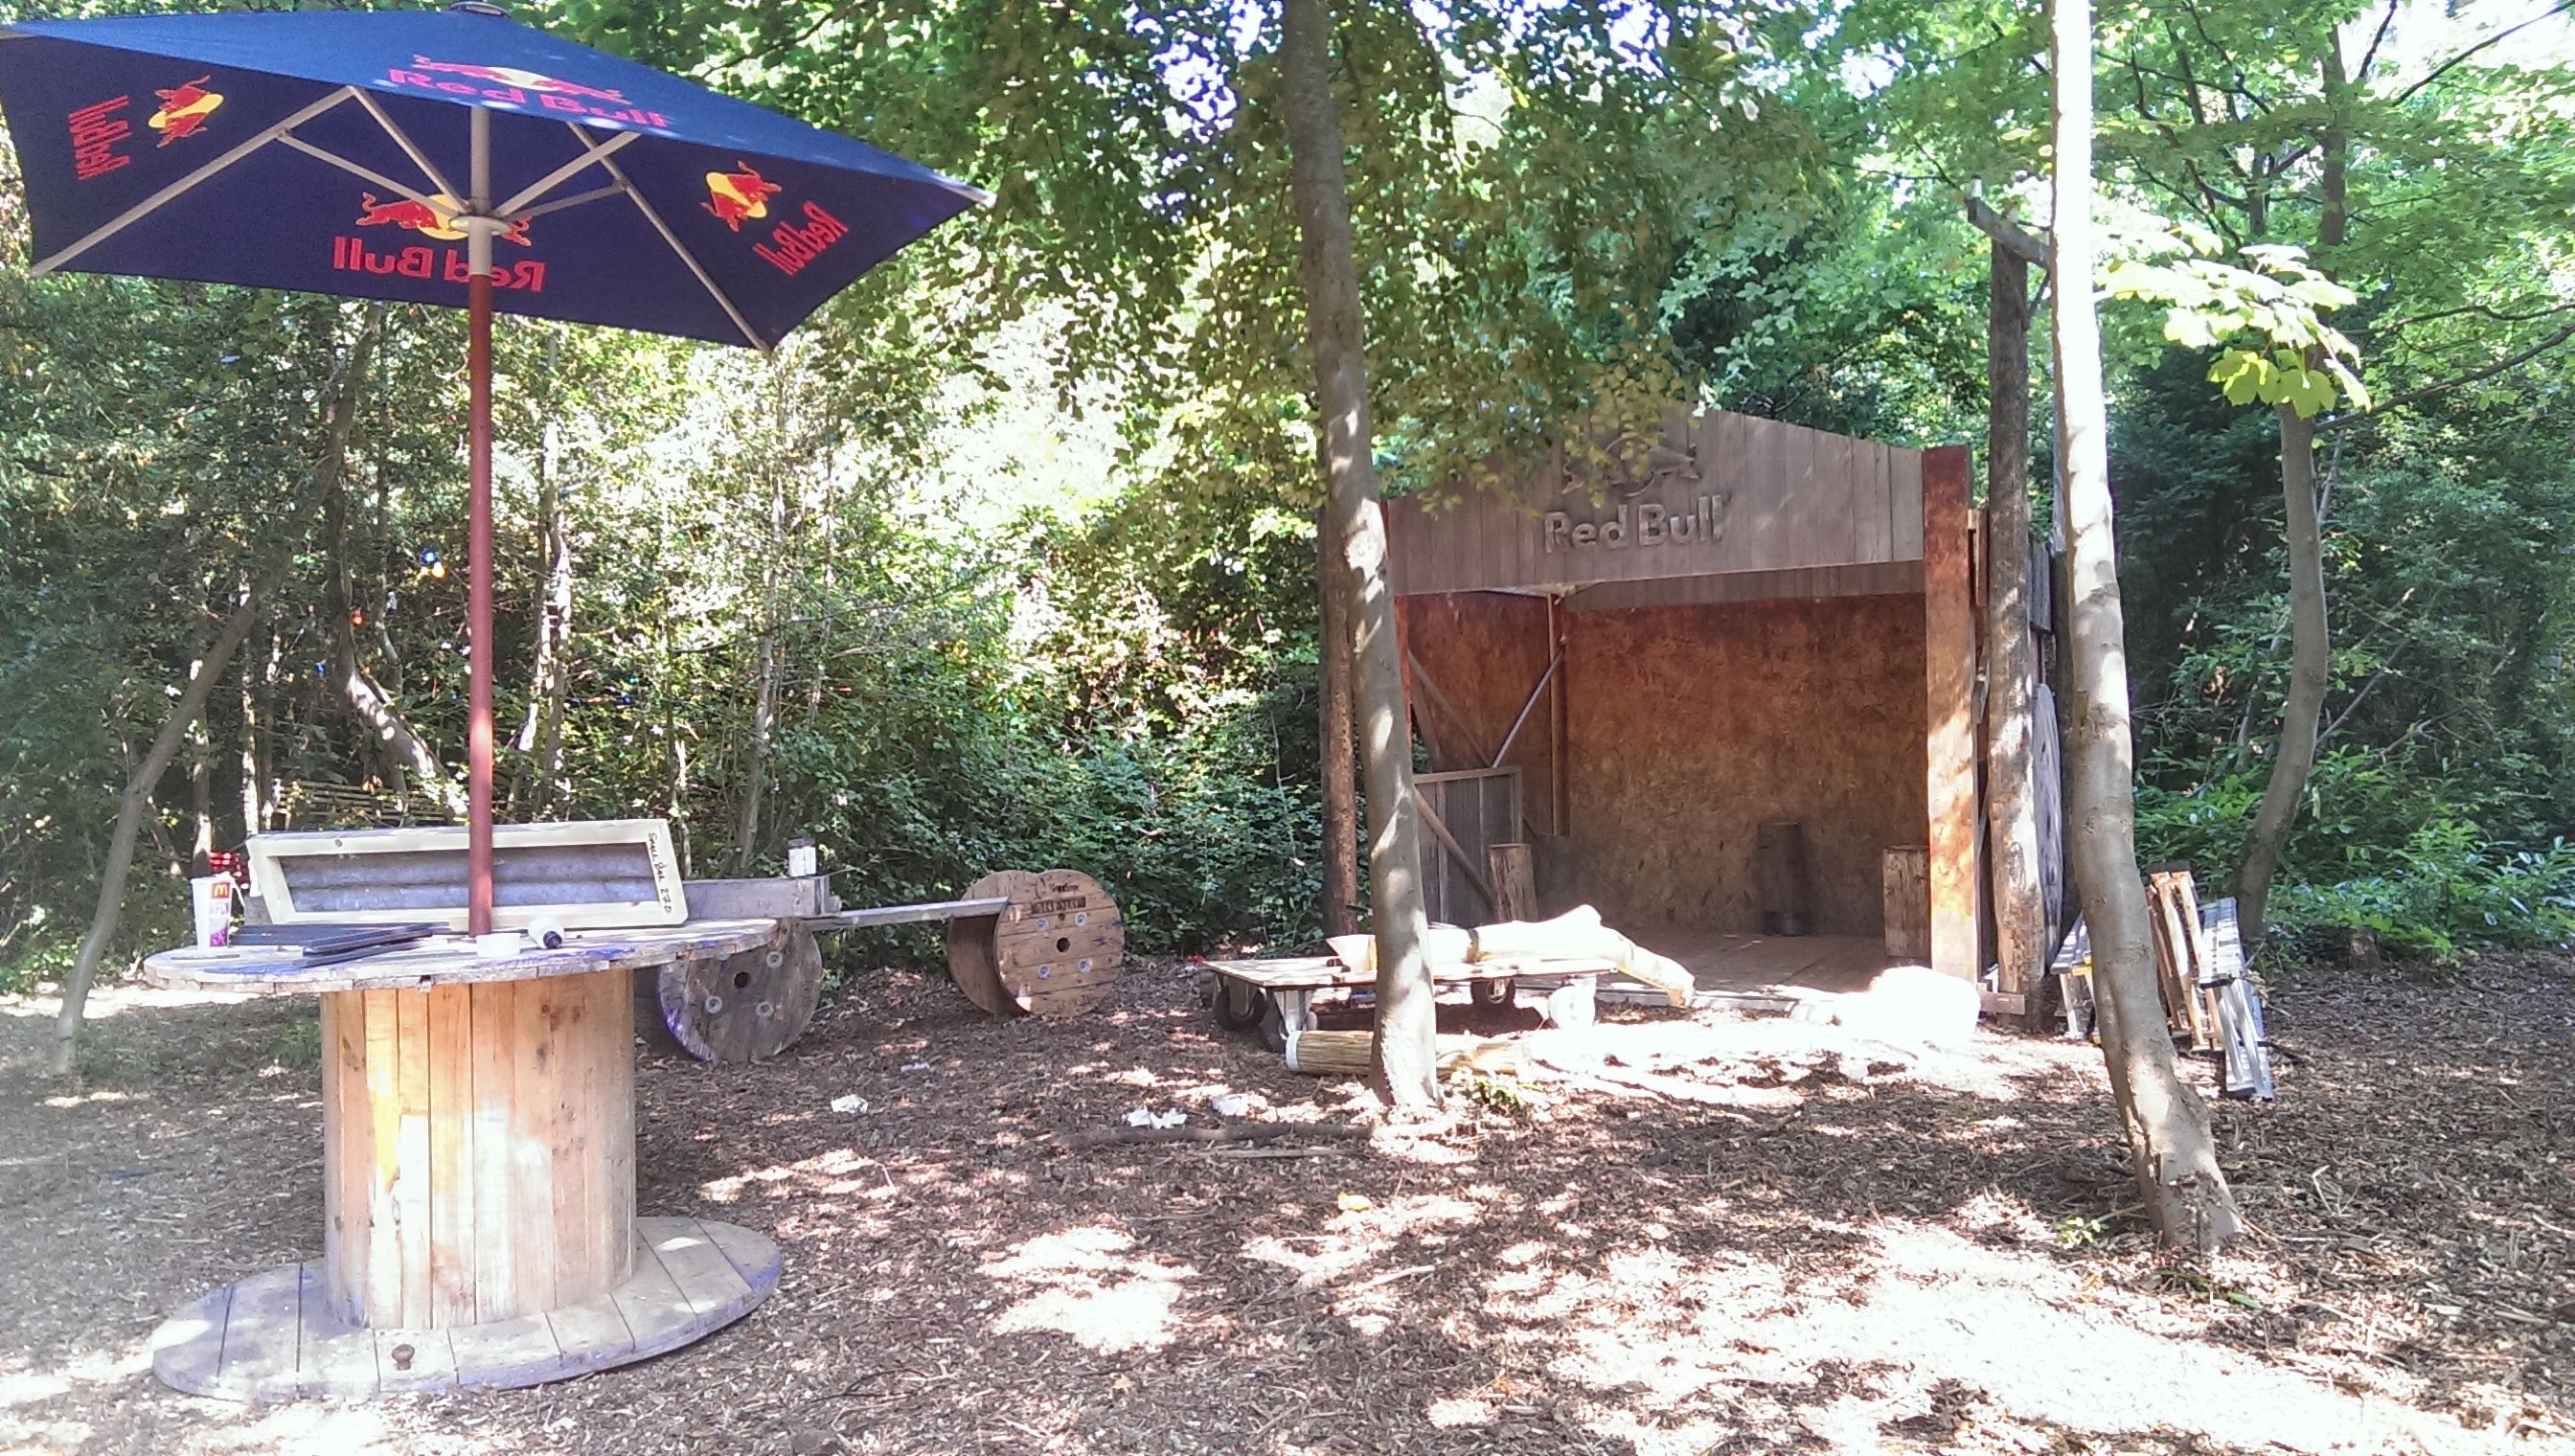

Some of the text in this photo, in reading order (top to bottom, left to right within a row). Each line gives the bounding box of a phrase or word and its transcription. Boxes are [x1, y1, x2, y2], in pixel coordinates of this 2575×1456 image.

[387, 67, 670, 128] Red Bull
[1543, 494, 1724, 554] Red Bull
